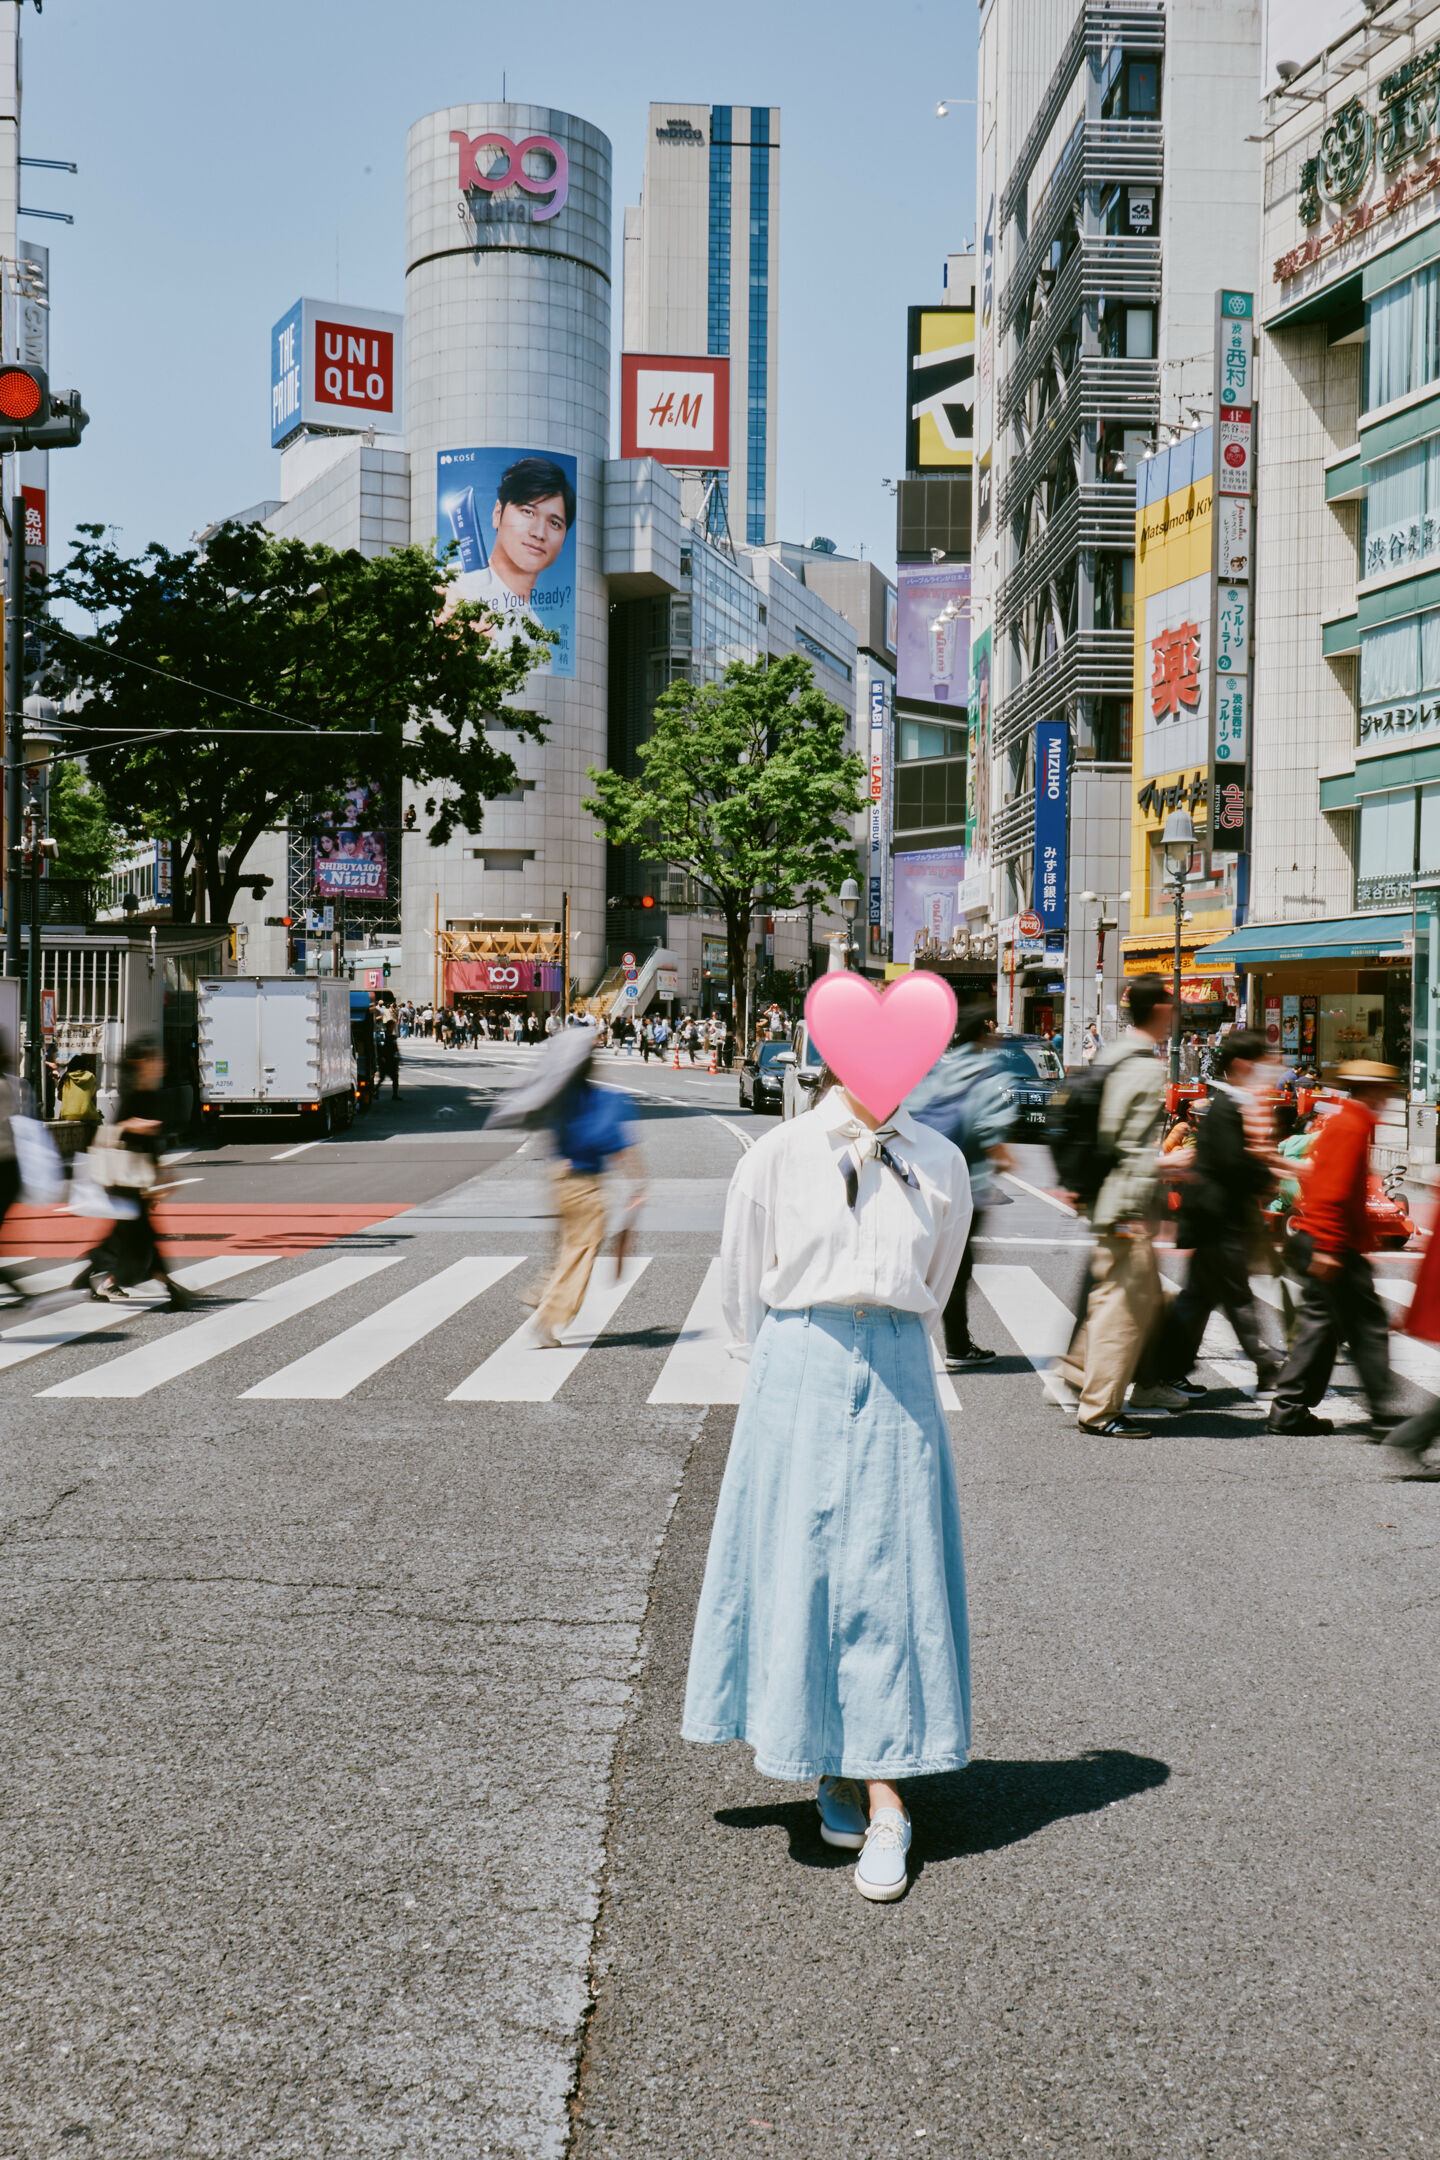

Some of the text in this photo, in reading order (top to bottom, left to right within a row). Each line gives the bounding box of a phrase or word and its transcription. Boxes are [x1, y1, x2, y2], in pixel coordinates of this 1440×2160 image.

[656, 128, 703, 139] INDIGO
[449, 130, 569, 222] 109
[278, 322, 295, 377] THE
[324, 331, 379, 368] UNI
[1226, 322, 1247, 388] 渋谷西村
[273, 364, 300, 430] PRIME
[324, 366, 384, 401] QLO
[648, 391, 703, 429] H&M
[453, 452, 475, 463] KOSÉ
[24, 508, 43, 546] 免税
[1141, 508, 1195, 542] Matsumoto
[1368, 531, 1405, 569] 渋谷
[502, 591, 526, 609] You
[529, 585, 572, 607] Ready?
[1220, 611, 1232, 653] パーラー
[1233, 604, 1244, 648] フルーツ
[1151, 621, 1201, 718] 薬
[872, 696, 883, 728] LABI
[1219, 698, 1230, 742] フルーツ
[1232, 693, 1243, 739] 渋谷西村
[871, 766, 882, 800] LABI
[1047, 738, 1062, 800] MIZUHO
[1220, 783, 1244, 829] HUB
[872, 809, 880, 853] SHIBUYA
[318, 861, 382, 873] SHIBUYA109
[329, 870, 381, 887] NiziU
[1043, 846, 1057, 912] みずほ銀行
[870, 893, 880, 923] LABI
[487, 966, 518, 989] 109
